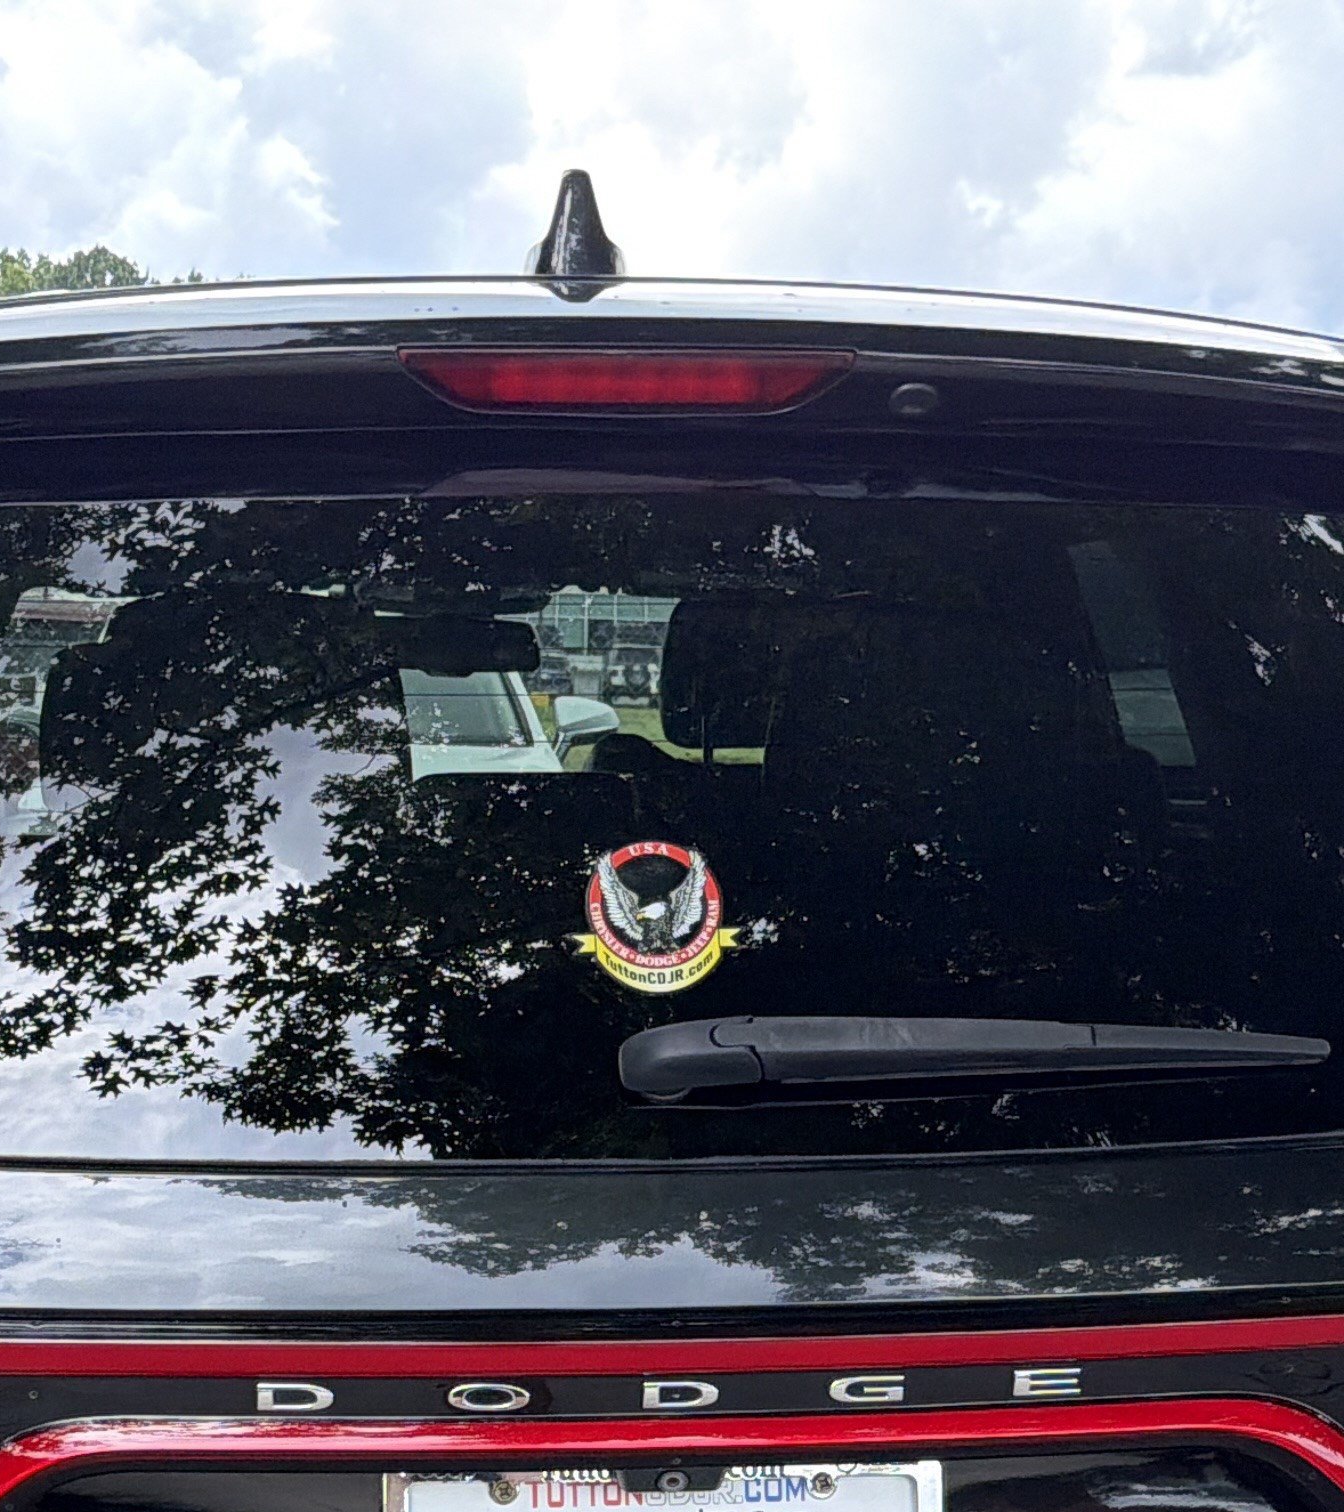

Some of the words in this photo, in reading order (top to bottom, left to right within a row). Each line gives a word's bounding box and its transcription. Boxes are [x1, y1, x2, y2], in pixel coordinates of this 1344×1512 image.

[629, 842, 669, 856] USA
[602, 951, 714, 985] TuttonCDJR.com
[635, 953, 681, 967] DODGE
[256, 1368, 1084, 1413] DODGE
